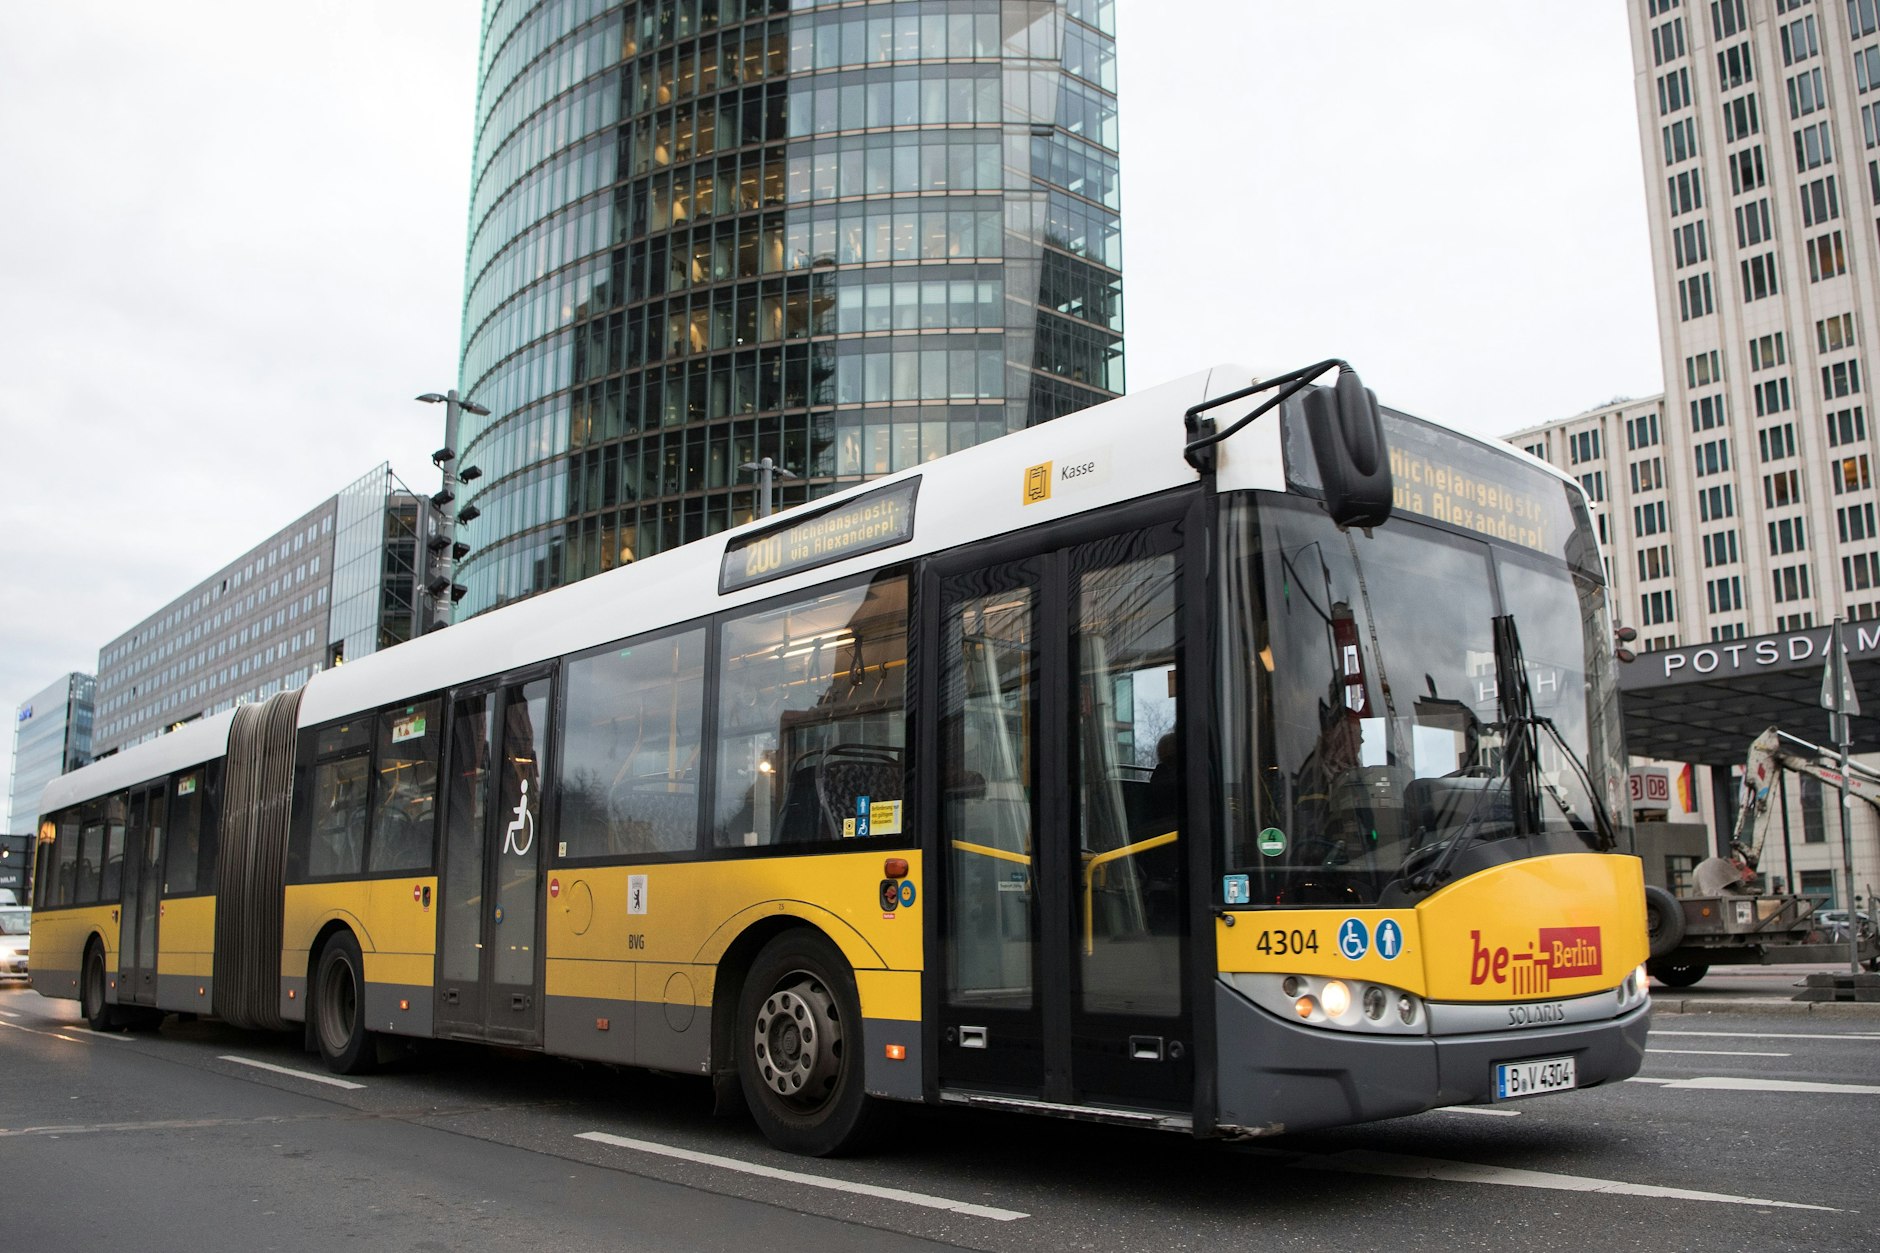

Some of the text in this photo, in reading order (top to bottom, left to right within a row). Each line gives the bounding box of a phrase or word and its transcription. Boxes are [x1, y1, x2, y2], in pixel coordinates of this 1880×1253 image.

[1061, 461, 1095, 481] Kasse
[1393, 481, 1423, 514] via
[745, 534, 783, 577] 200
[791, 543, 809, 562] via
[1648, 777, 1667, 798] DB
[1268, 830, 1277, 842] 4
[628, 934, 645, 949] BVG
[1256, 929, 1319, 955] 4304
[1470, 930, 1597, 985] be Berlin
[1508, 1003, 1565, 1026] SOLARIS
[1540, 1062, 1569, 1088] 4304
